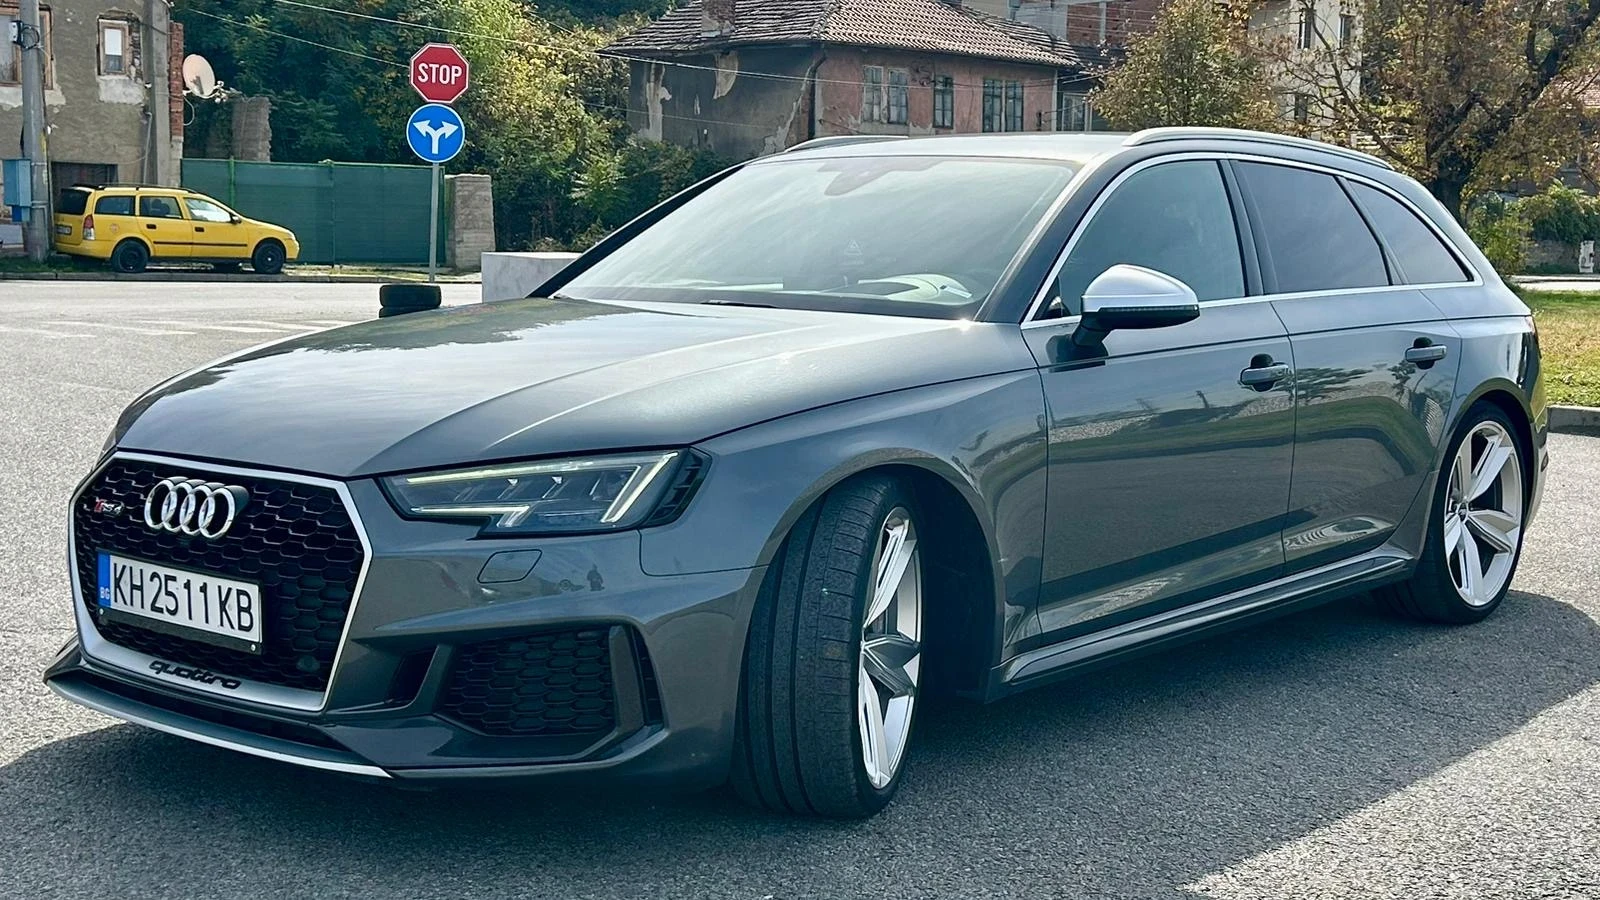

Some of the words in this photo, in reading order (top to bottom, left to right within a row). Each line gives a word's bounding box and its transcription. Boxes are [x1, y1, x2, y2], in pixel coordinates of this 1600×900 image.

[417, 62, 463, 85] STOP
[100, 587, 111, 599] BG
[149, 660, 242, 690] quattro
